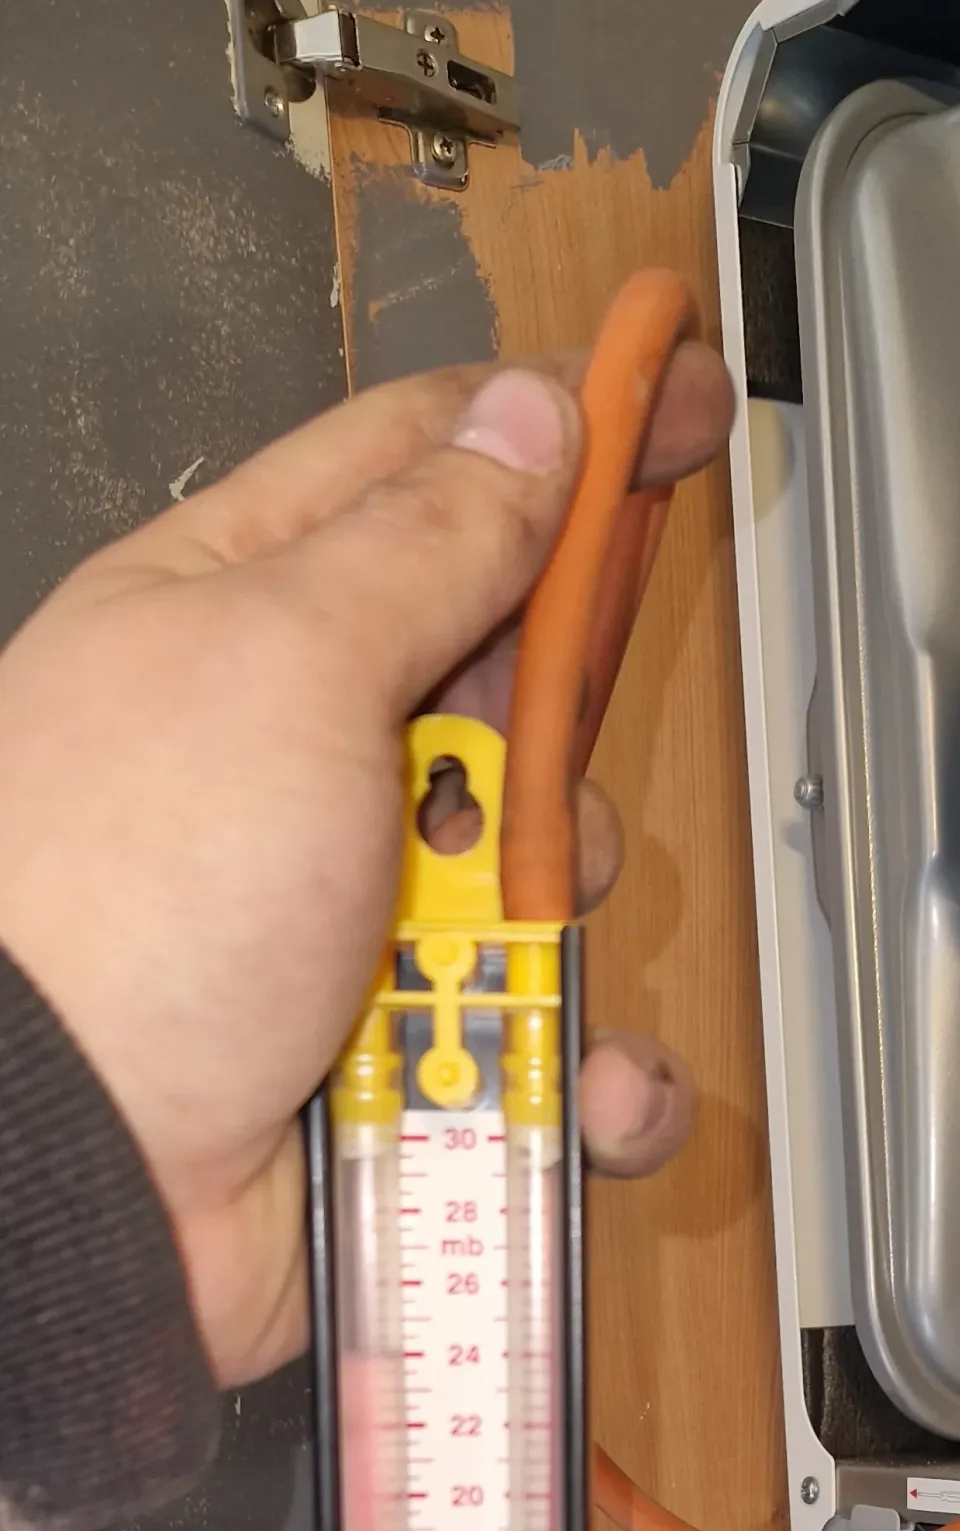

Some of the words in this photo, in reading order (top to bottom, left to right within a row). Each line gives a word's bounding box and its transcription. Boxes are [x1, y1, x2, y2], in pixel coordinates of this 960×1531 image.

[444, 1128, 477, 1150] 30
[445, 1201, 478, 1223] 28
[441, 1237, 484, 1256] mb
[447, 1273, 480, 1295] 26
[447, 1344, 481, 1366] 24
[449, 1414, 482, 1437] 22
[450, 1486, 485, 1507] 20
